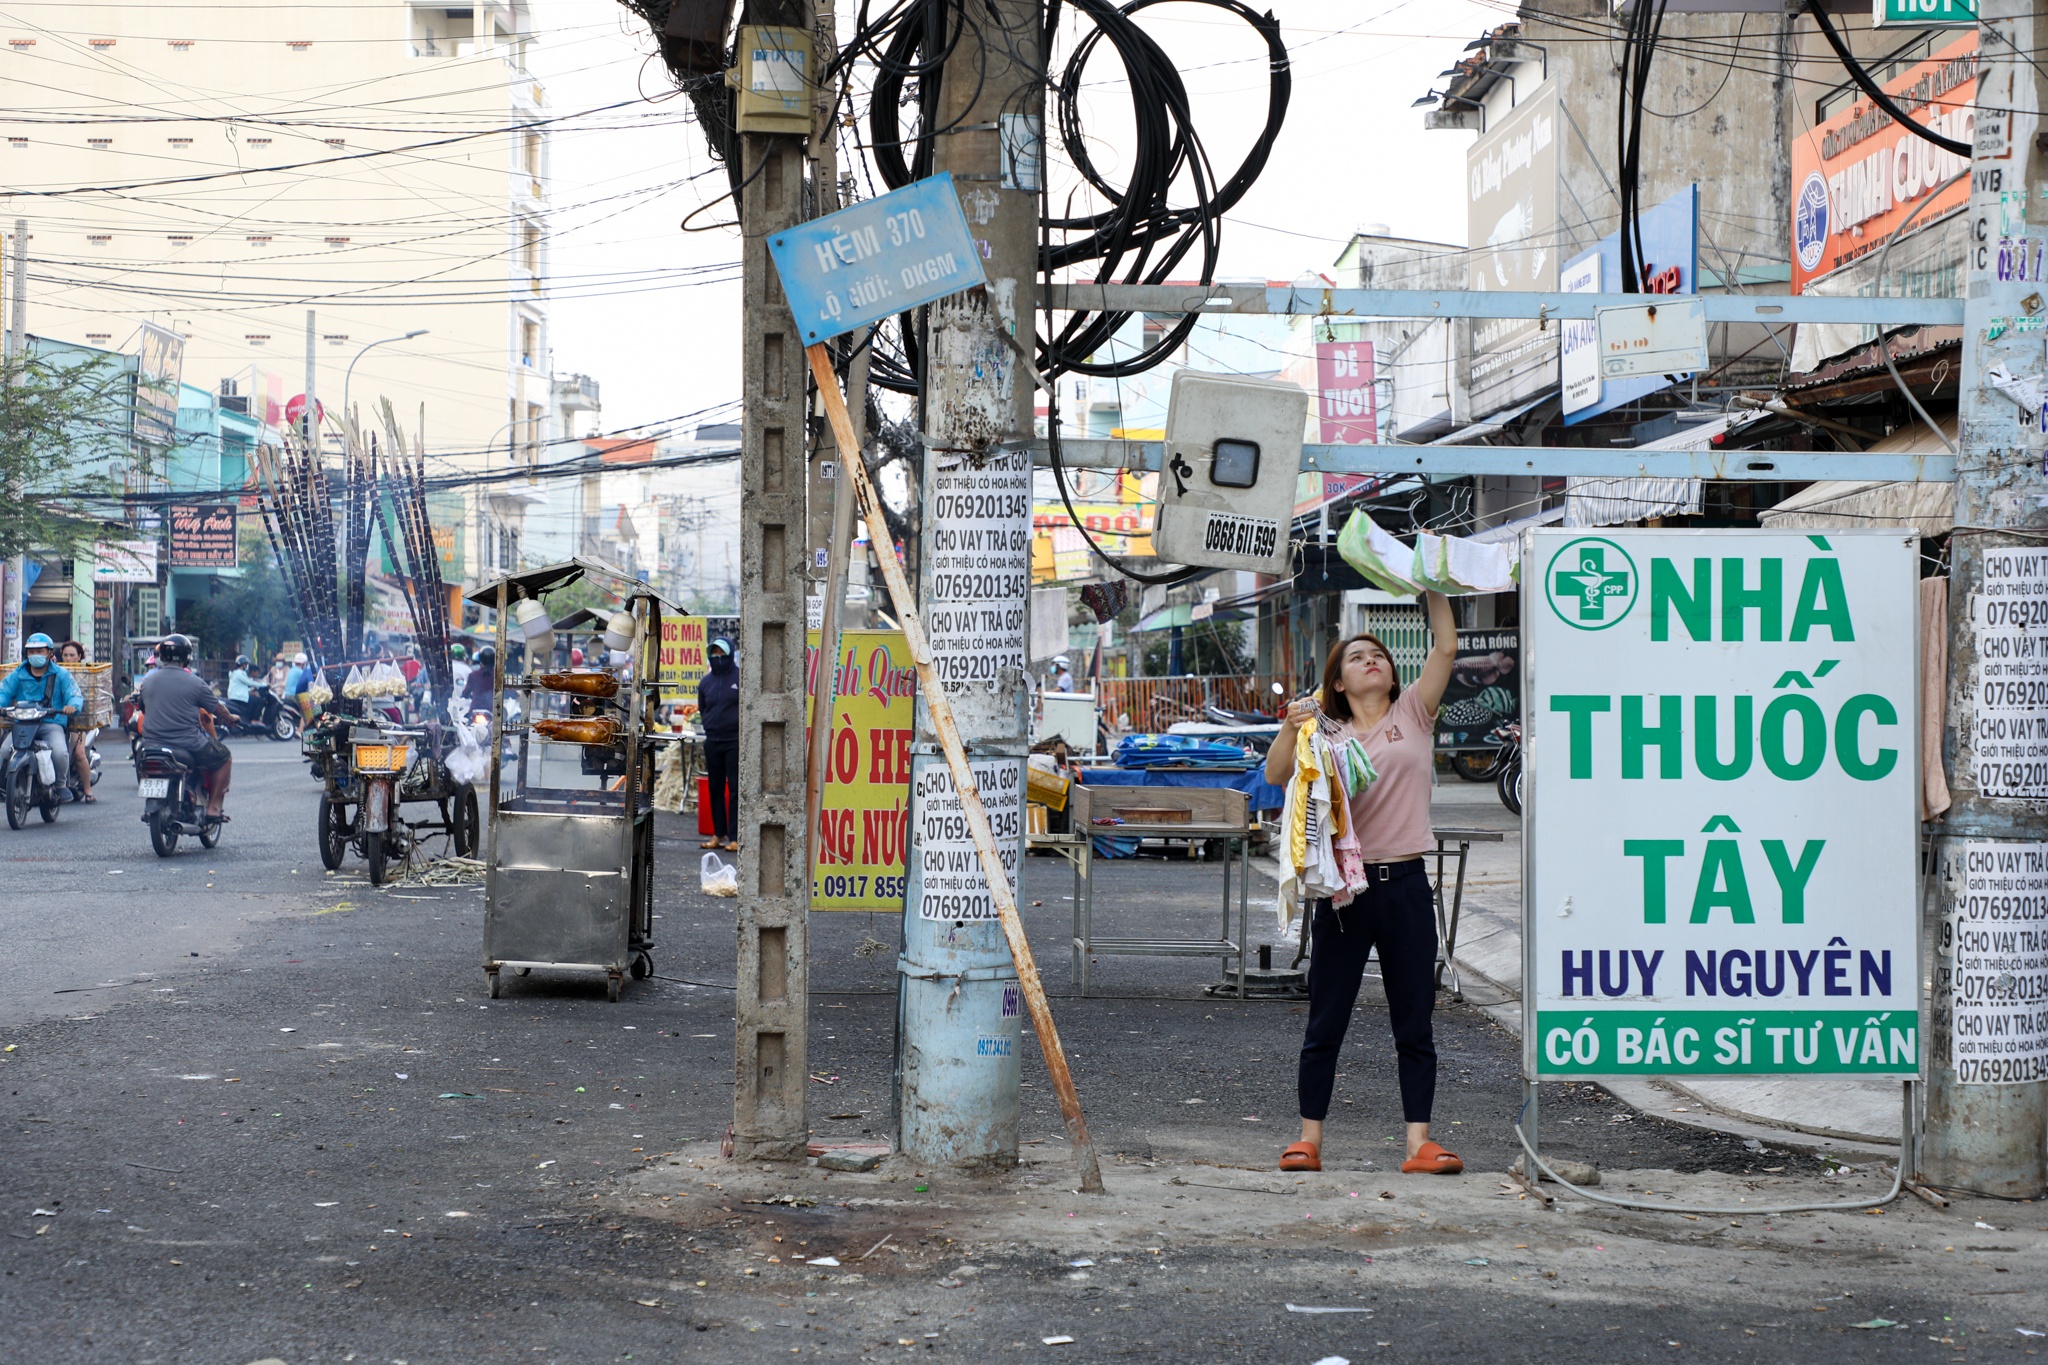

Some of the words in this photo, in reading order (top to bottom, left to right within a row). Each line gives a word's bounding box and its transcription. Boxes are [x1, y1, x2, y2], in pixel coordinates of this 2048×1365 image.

[814, 224, 881, 274] HẺM
[886, 208, 926, 248] 370
[1334, 344, 1359, 378] DÊ
[936, 475, 952, 490] GIỚI
[954, 474, 977, 492] THIỆU
[979, 475, 990, 490] CÓ
[992, 478, 1008, 490] HOA
[1010, 474, 1027, 490] HỒNG
[936, 494, 1027, 519] 0769201345
[935, 529, 956, 552] CHO
[958, 529, 984, 552] VAY
[985, 523, 1008, 552] TRẢ
[1009, 523, 1027, 552] GÓP
[1205, 518, 1277, 558] 0868.611.599
[935, 555, 950, 569] GIỚI
[951, 554, 975, 571] THIỆU
[976, 555, 988, 569] CÓ
[990, 557, 1007, 569] HOA
[1008, 554, 1026, 569] HỒNG
[1985, 556, 2012, 579] CHO
[2015, 555, 2039, 578] VAY
[935, 574, 1026, 599] 0769201345
[1603, 584, 1624, 596] CPP
[1651, 535, 1856, 642] NHÀ
[1986, 581, 2005, 596] GIỚI
[2006, 581, 2032, 598] THIỆU
[2033, 580, 2044, 595] CÓ
[931, 611, 952, 634] CHO
[954, 610, 979, 633] VAY
[980, 603, 1004, 632] TRẢ
[1005, 603, 1024, 632] GÓP
[680, 644, 703, 666] MÁ
[932, 636, 946, 651] GIỚI
[948, 635, 970, 653] THIỆU
[972, 635, 984, 650] CÓ
[985, 638, 1003, 650] HOA
[1004, 634, 1023, 649] HỒNG
[1984, 636, 2010, 659] CHO
[2012, 635, 2037, 659] VAY
[1984, 661, 2003, 676] GIỚI
[2005, 660, 2029, 679] THIỆU
[1550, 660, 1898, 781] THUỐC
[1979, 717, 2006, 740] CHO
[2009, 717, 2034, 740] VAY
[1981, 743, 1998, 758] GIỚI
[2001, 743, 2025, 760] THIỆU
[2027, 742, 2039, 758] CÓ
[925, 772, 946, 794] CHO
[974, 763, 997, 792] TRẢ
[999, 762, 1018, 790] GÓP
[926, 798, 940, 812] GIỚI
[998, 792, 1018, 807] HỒNG
[923, 850, 945, 872] CHO
[947, 850, 972, 873] VAY
[1623, 815, 1827, 924] TÂY
[1968, 850, 1995, 874] CHO
[1997, 851, 2022, 874] VAY
[2024, 845, 2044, 873] TRẢ
[824, 875, 869, 899] 0917
[923, 876, 939, 890] GIỚI
[939, 876, 963, 893] THIỆU
[964, 876, 977, 891] CÓ
[1969, 876, 1987, 891] GIỚI
[1988, 876, 2014, 894] THIỆU
[2015, 876, 2027, 891] CÓ
[2028, 879, 2044, 892] HOA
[1964, 930, 1989, 953] CHO
[1992, 931, 2017, 954] VAY
[2020, 924, 2041, 953] TRẢ
[1562, 949, 1665, 997] HUY
[1685, 937, 1892, 997] NGUYÊN
[1964, 955, 1983, 971] GIỚI
[2025, 958, 2039, 971] HOA
[1957, 1014, 1984, 1037] CHO
[1986, 1014, 2011, 1036] VAY
[2013, 1008, 2034, 1035] TRẢ
[1545, 1017, 1600, 1066] CÓ
[1617, 1017, 1700, 1066] BÁC
[1713, 1017, 1756, 1066] SĨ
[1765, 1019, 1824, 1065] TƯ
[1832, 1011, 1916, 1065] VẤN
[1959, 1040, 1977, 1054] GIỚI
[1978, 1040, 2003, 1057] THIỆU
[2005, 1038, 2017, 1053] CÓ
[2019, 1041, 2034, 1052] HOA
